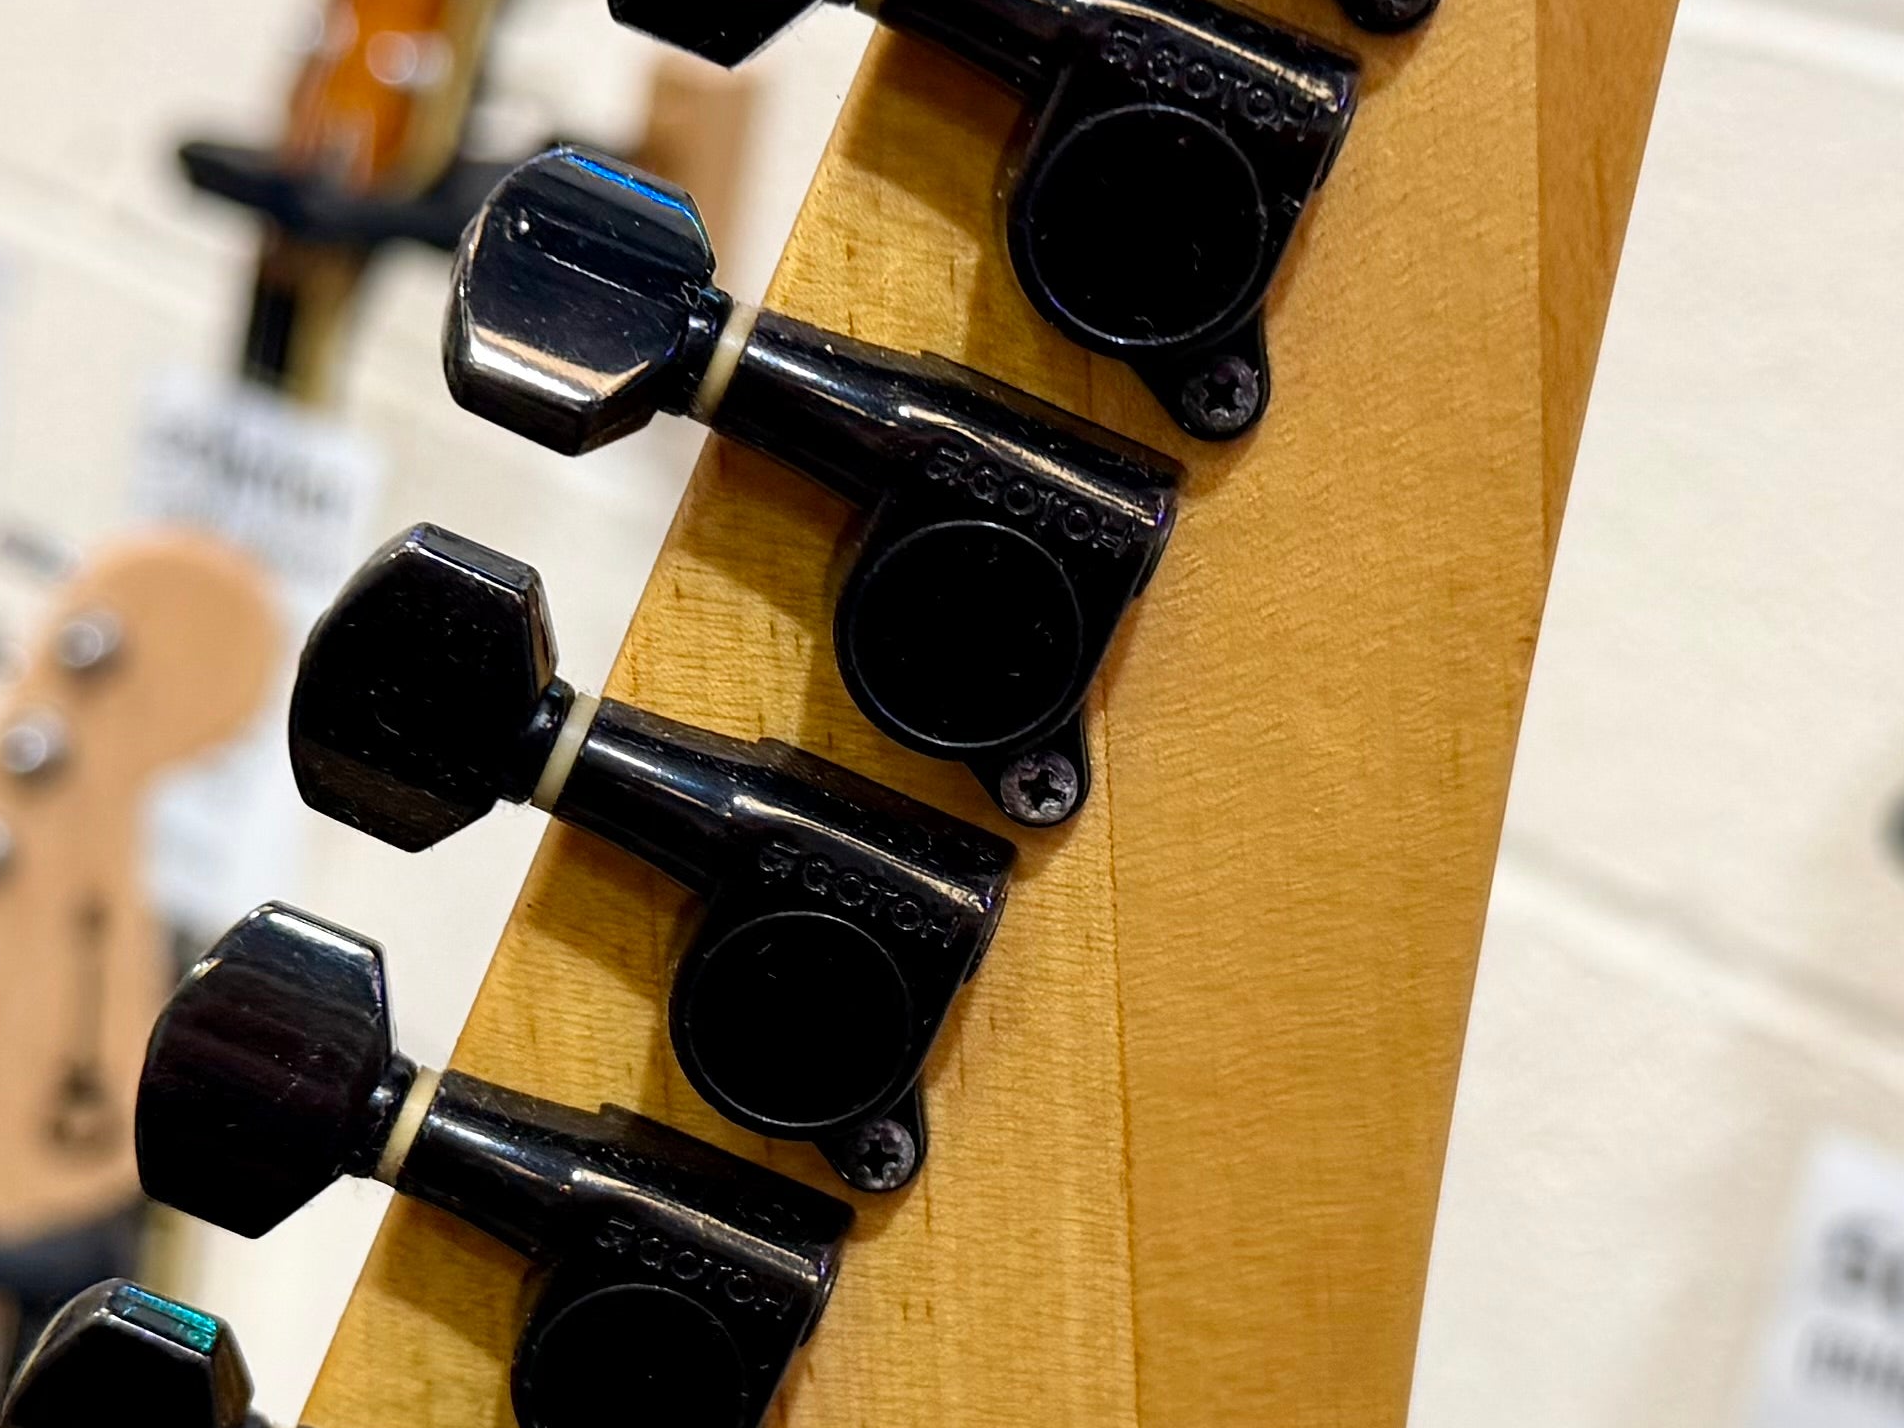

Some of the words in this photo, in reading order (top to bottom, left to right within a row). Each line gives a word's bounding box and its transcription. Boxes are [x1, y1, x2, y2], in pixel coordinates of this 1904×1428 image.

[1146, 48, 1319, 141] GOTOH
[967, 465, 1136, 558] GOTOH
[802, 859, 961, 949] GOTOH
